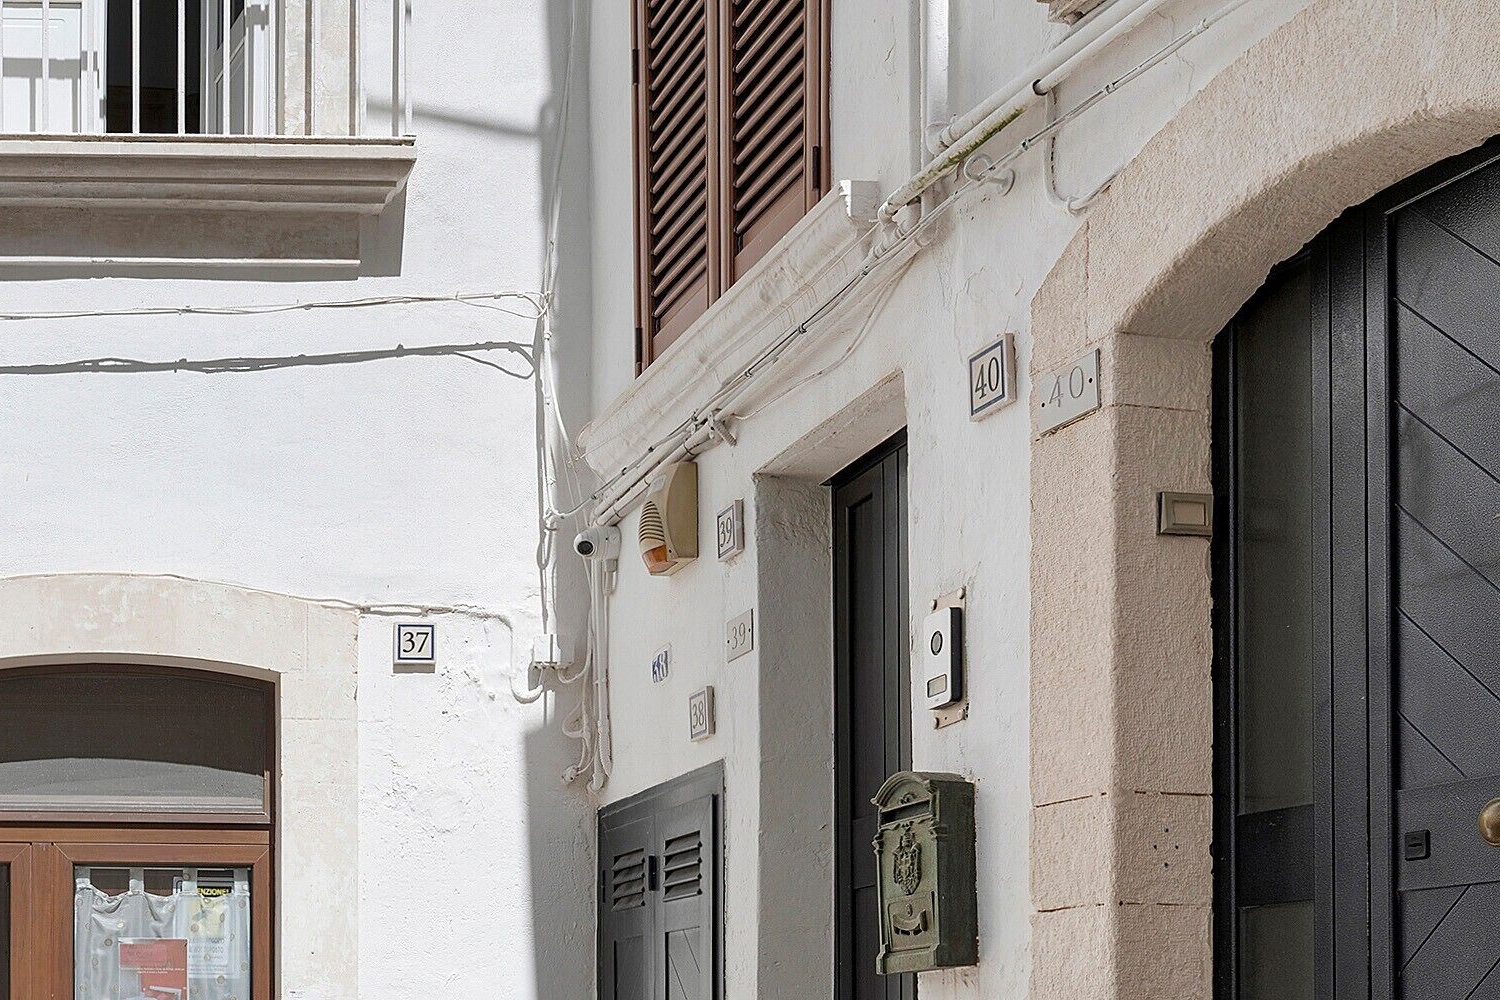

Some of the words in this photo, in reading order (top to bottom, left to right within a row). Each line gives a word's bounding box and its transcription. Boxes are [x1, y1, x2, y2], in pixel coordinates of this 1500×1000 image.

[974, 356, 1000, 400] 40
[1048, 365, 1084, 408] 40
[719, 516, 733, 548] 39
[402, 631, 430, 653] 37
[731, 622, 746, 650] 39
[691, 700, 705, 730] 38
